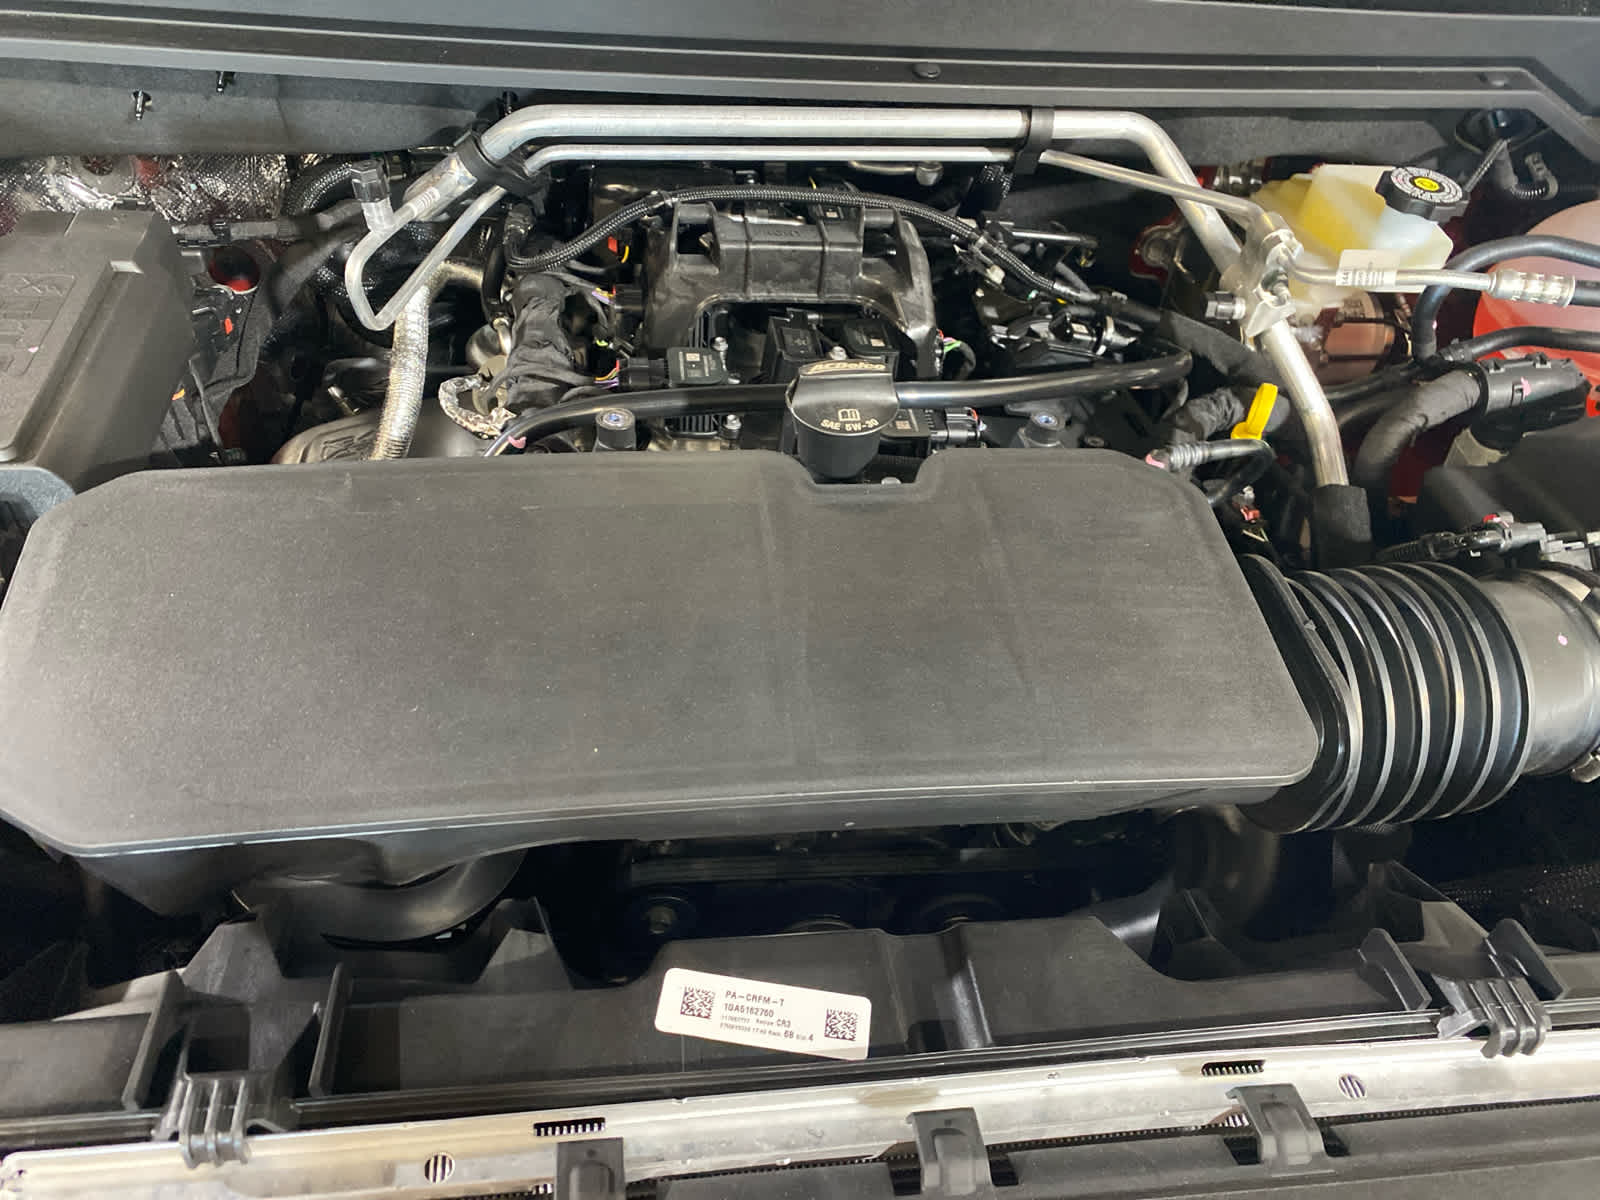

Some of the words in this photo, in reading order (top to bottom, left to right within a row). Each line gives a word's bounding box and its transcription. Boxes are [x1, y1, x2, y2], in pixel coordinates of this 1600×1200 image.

[807, 362, 886, 374] ACDelco
[821, 419, 841, 430] SAE
[844, 418, 879, 431] 5W-30
